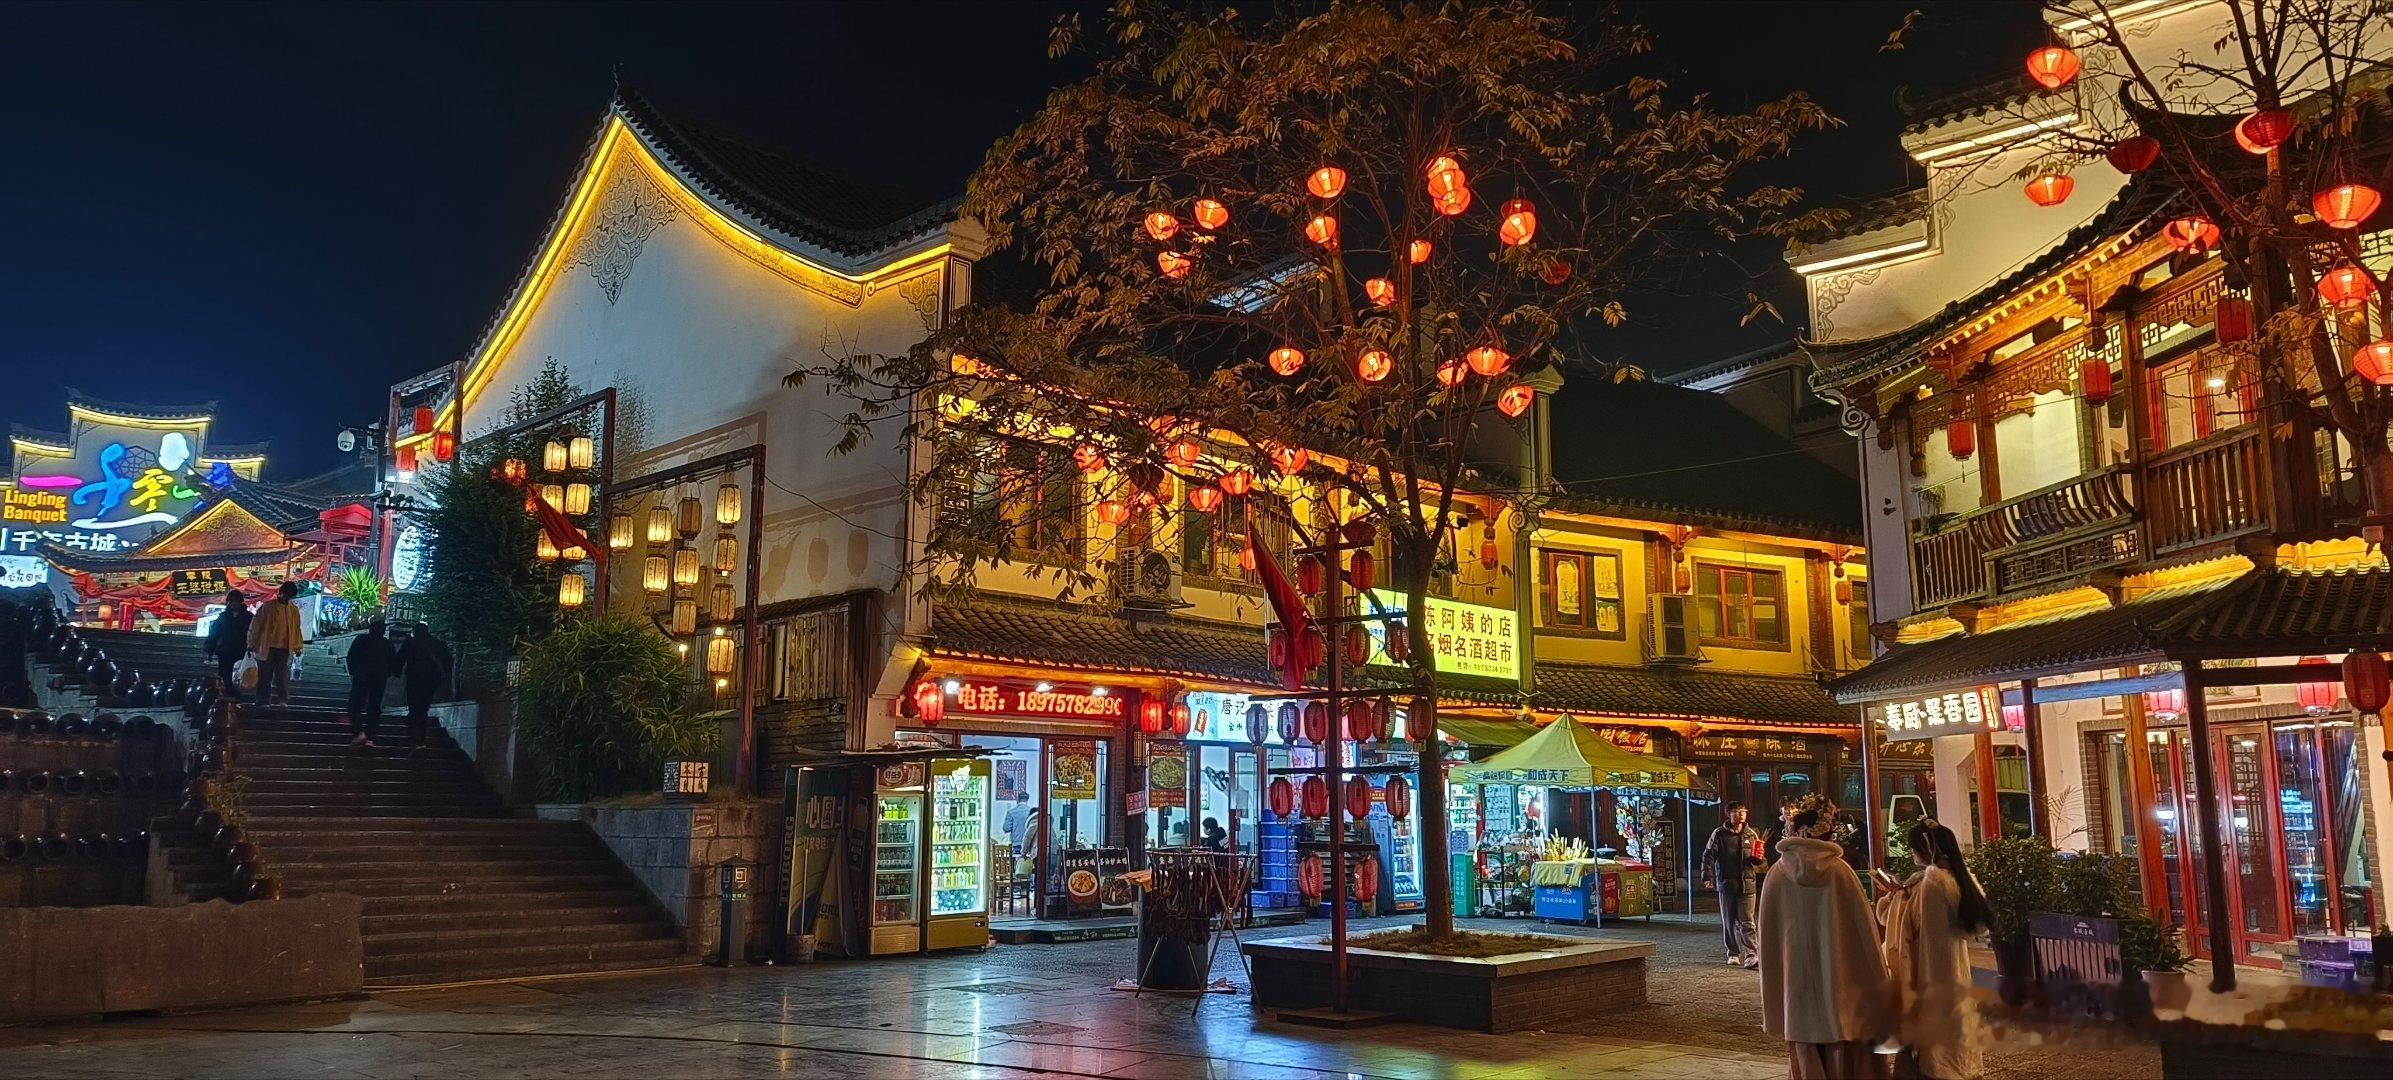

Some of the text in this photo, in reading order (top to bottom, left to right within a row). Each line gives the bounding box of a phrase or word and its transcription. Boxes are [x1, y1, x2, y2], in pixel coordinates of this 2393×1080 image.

[4, 489, 68, 509] Lingling
[3, 505, 68, 523] Banquet
[1527, 768, 1570, 782] 和成天下
[780, 816, 795, 899] TUBORG
